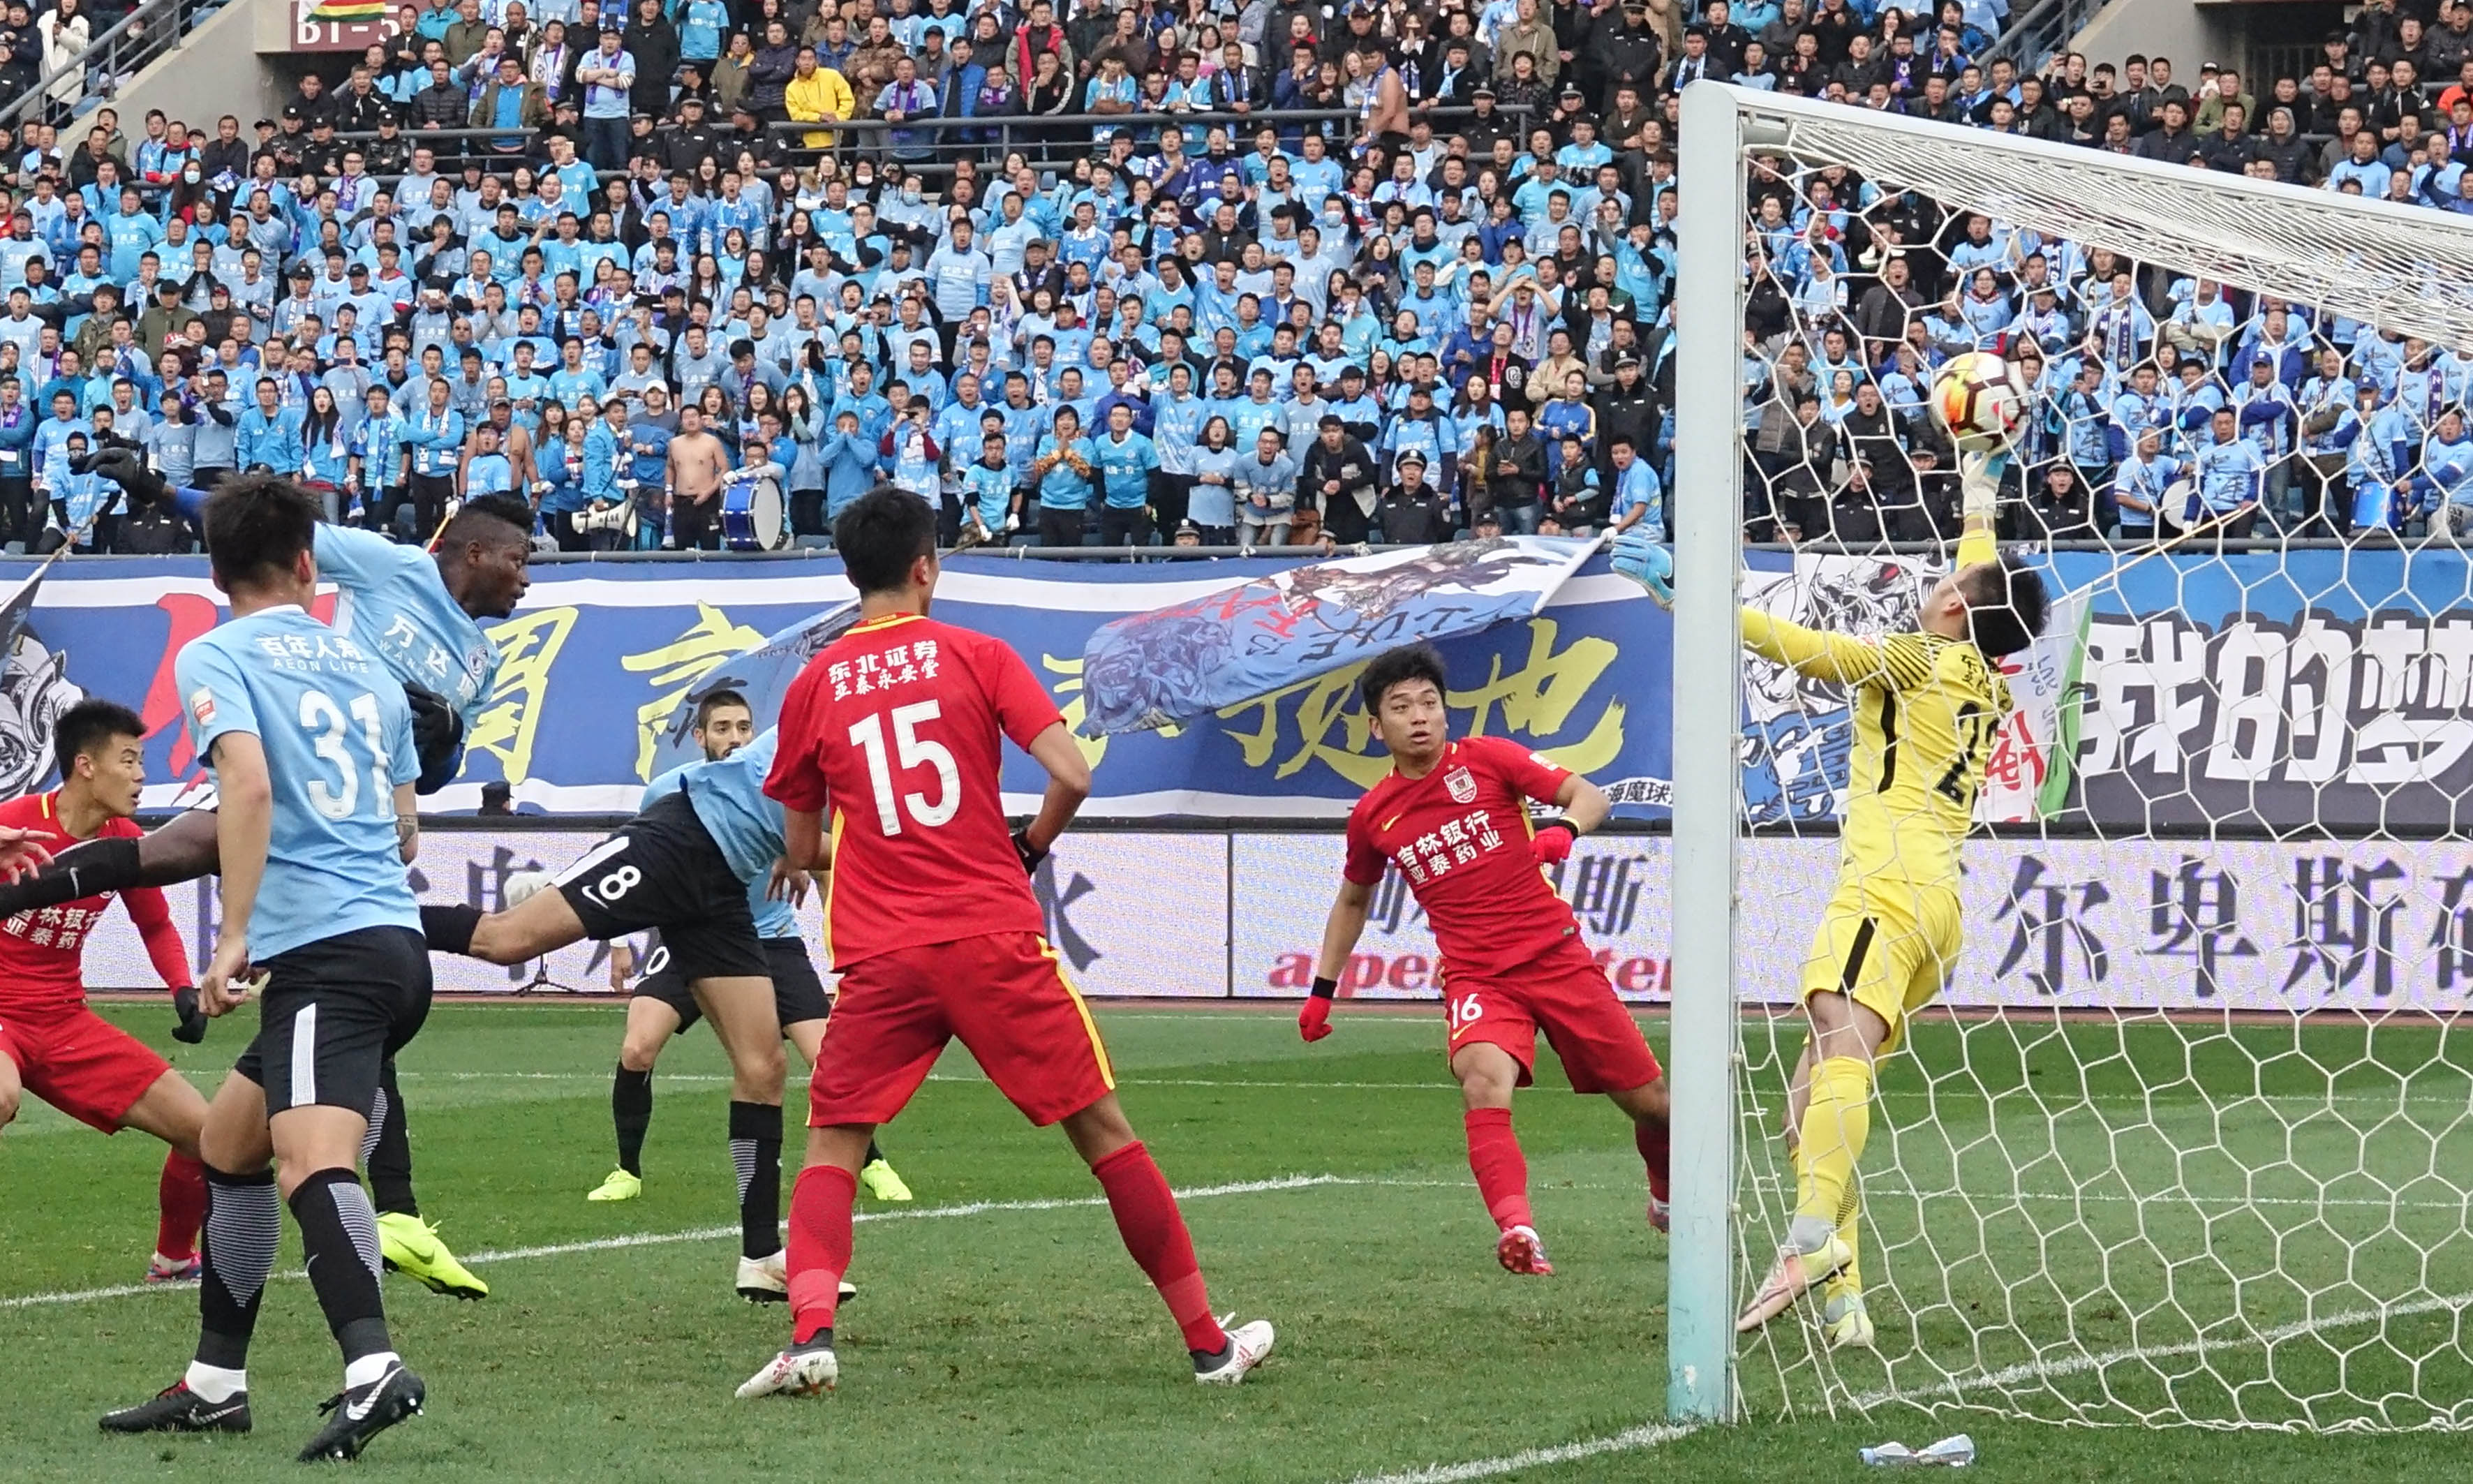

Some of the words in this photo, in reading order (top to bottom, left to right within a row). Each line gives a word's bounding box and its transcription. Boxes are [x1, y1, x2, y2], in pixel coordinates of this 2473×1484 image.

[255, 634, 364, 661] 百年人寿
[273, 658, 321, 671] AEON
[329, 660, 369, 674] LIFE
[828, 639, 938, 685] 东北证券
[833, 659, 940, 702] 亚泰永安堂
[299, 690, 390, 819] 31
[848, 699, 961, 837] 15
[1397, 810, 1490, 868] 吉林银行
[1409, 829, 1503, 884] 亚泰药业
[599, 865, 641, 900] 8
[2, 916, 85, 949] 亚泰药
[1451, 993, 1483, 1030] 16
